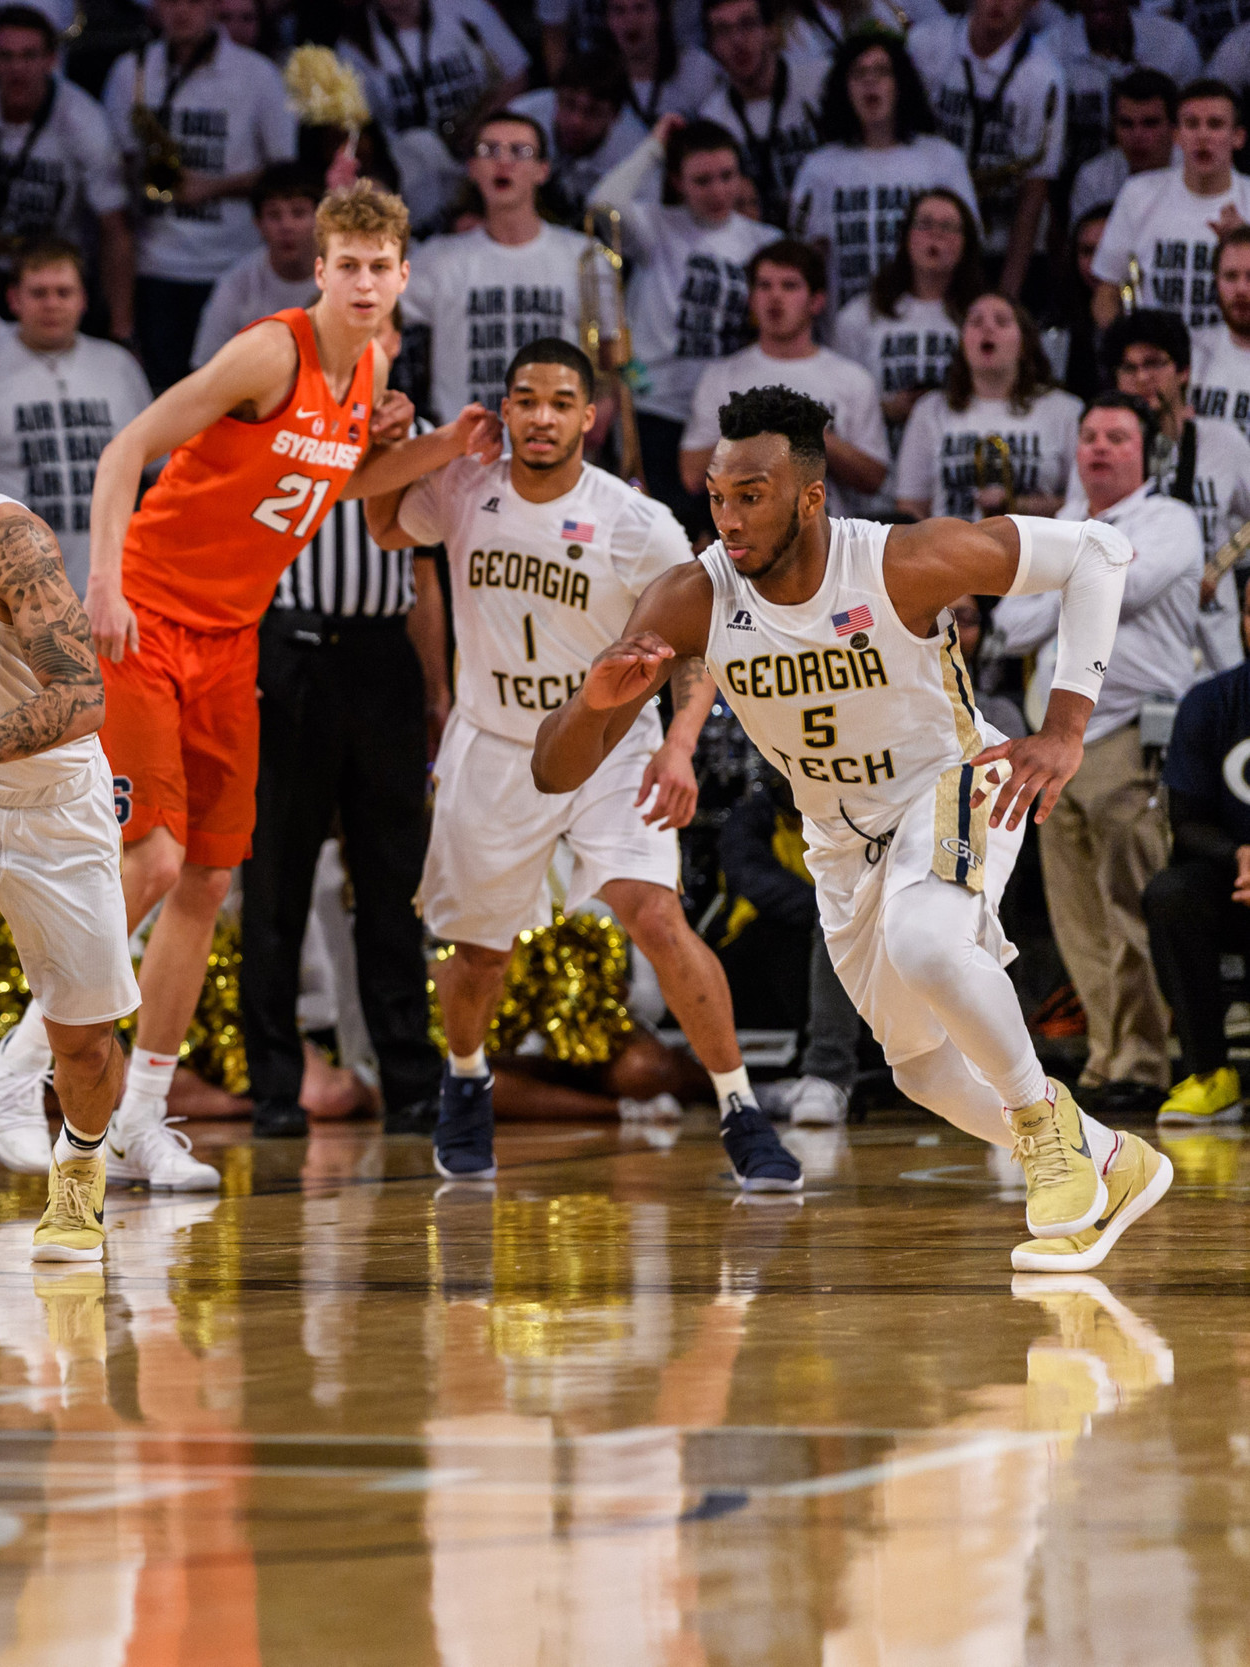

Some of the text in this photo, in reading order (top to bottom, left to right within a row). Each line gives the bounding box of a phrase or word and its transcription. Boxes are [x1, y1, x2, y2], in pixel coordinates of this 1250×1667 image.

[251, 472, 331, 539] 21
[469, 549, 591, 612] GEORGIA
[523, 612, 537, 662] 1
[726, 647, 890, 699] GEORGIA
[802, 703, 837, 749] 5
[772, 745, 896, 786] TECH
